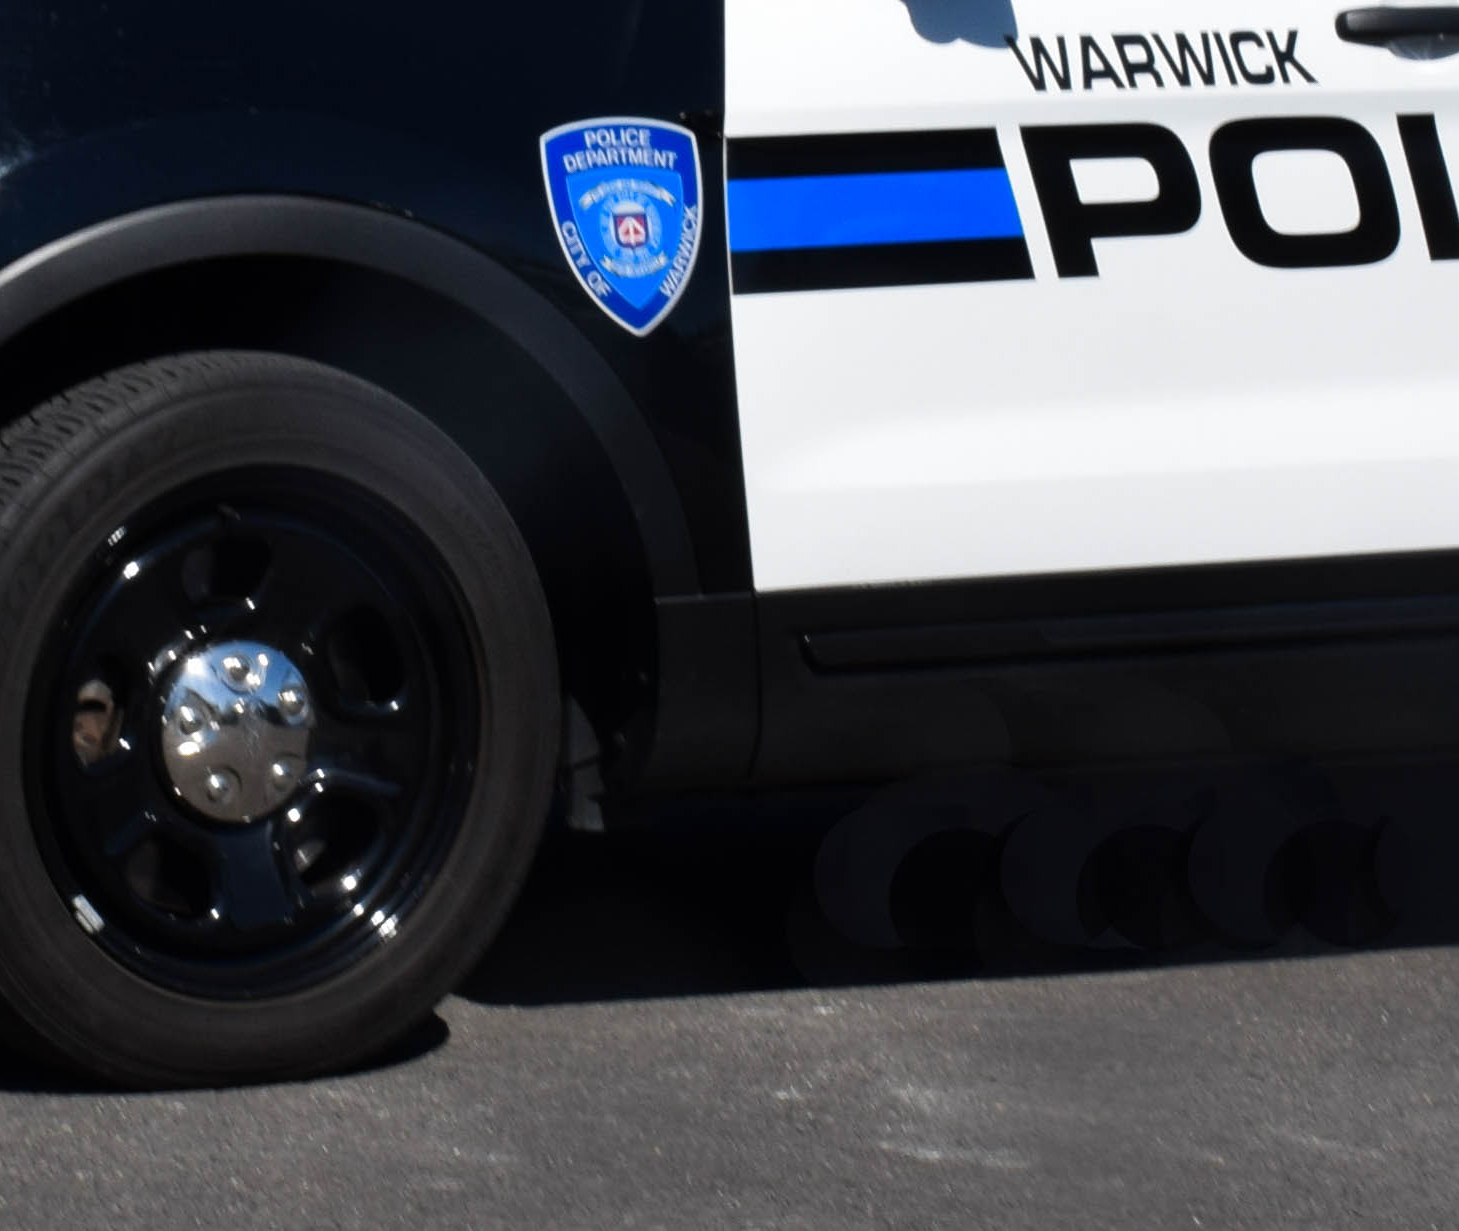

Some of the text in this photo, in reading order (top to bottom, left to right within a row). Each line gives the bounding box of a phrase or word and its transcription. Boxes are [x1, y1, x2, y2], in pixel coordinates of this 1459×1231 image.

[1008, 29, 1318, 93] WARWICK
[563, 148, 678, 173] DEPARTMENT
[584, 128, 651, 148] POLICE
[561, 220, 612, 297] CITY OF
[659, 205, 698, 298] WARWICK
